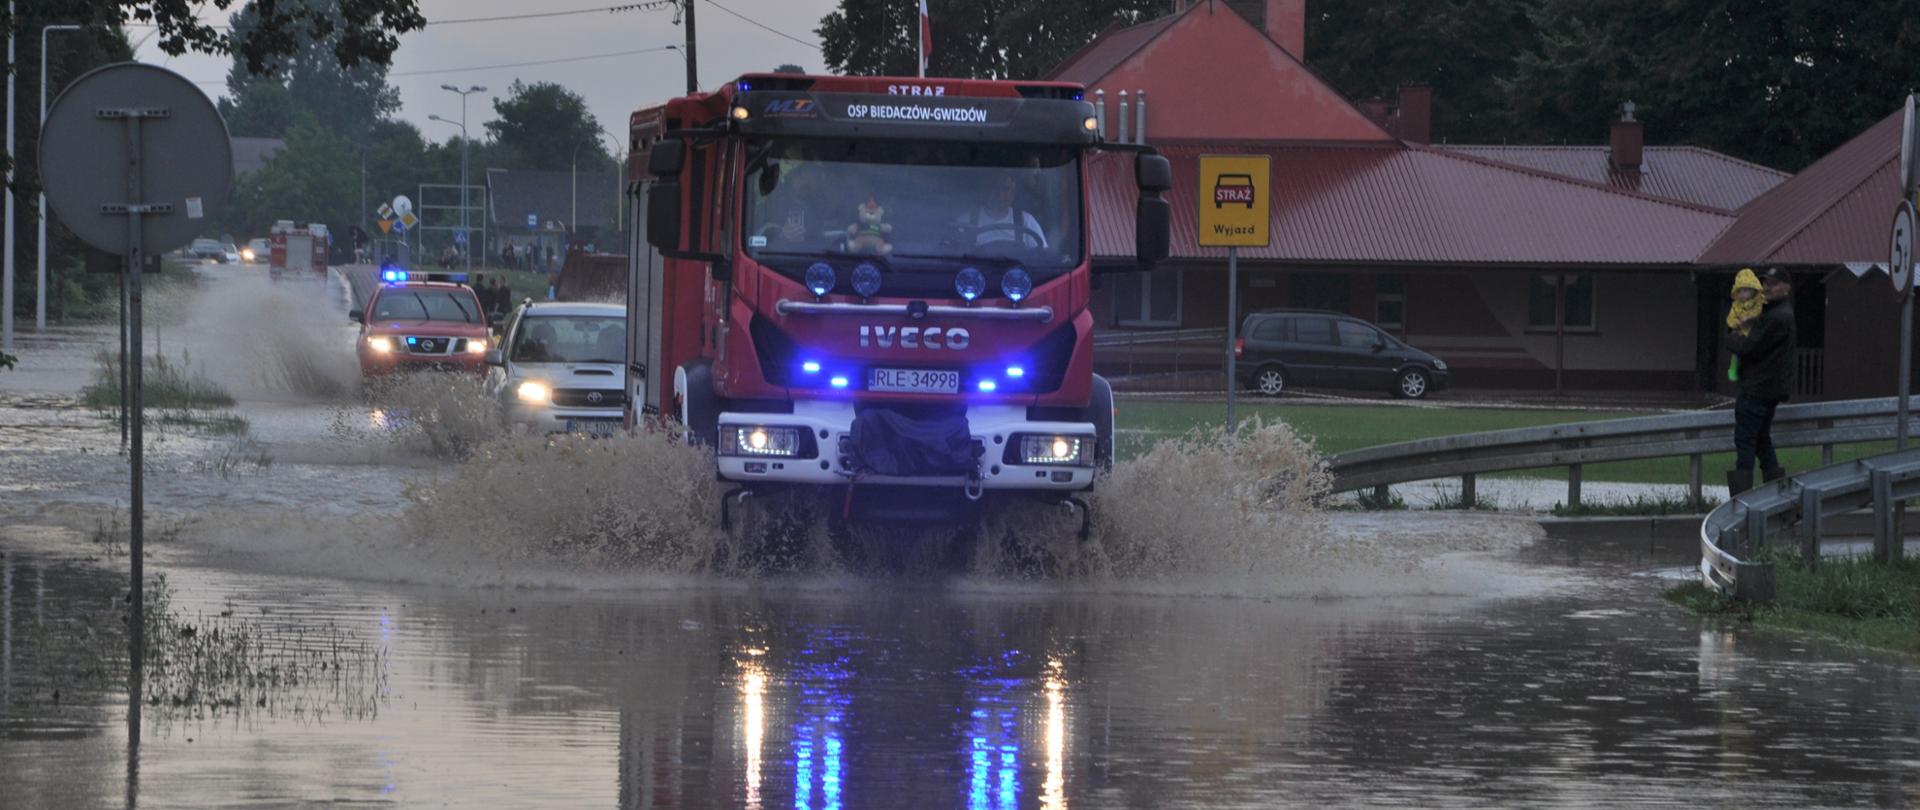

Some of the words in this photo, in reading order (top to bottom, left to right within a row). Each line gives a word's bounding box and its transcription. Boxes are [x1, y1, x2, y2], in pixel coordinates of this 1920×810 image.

[847, 104, 867, 118] OSP
[870, 105, 987, 122] BIEDACZÓW-GWIZDÓW
[1217, 187, 1252, 200] STRAŻ
[1214, 224, 1255, 236] Wyjazd
[1894, 228, 1903, 274] 5
[860, 325, 970, 350] IVECO
[875, 370, 906, 387] RLE
[911, 373, 958, 389] 34998
